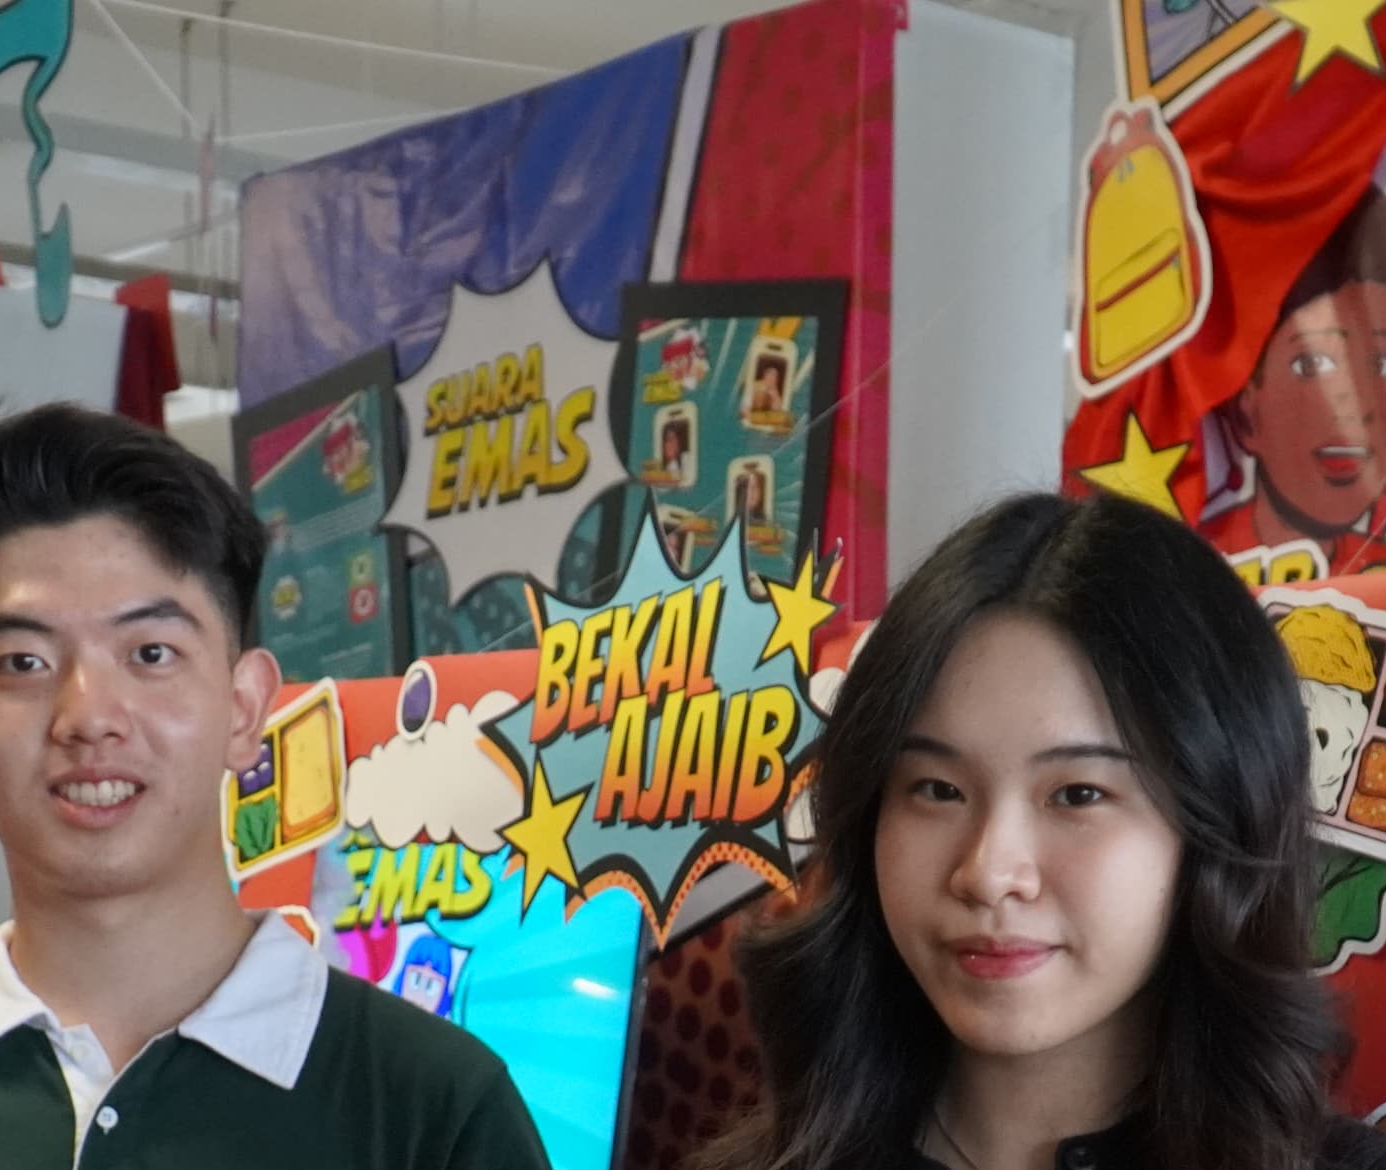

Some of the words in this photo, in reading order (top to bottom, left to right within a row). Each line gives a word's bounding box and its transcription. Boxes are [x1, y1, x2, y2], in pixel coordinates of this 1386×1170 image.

[424, 343, 544, 435] SUARA
[426, 386, 596, 520] EMAS
[530, 577, 726, 747] BEKAL
[594, 685, 800, 828] AJAIB
